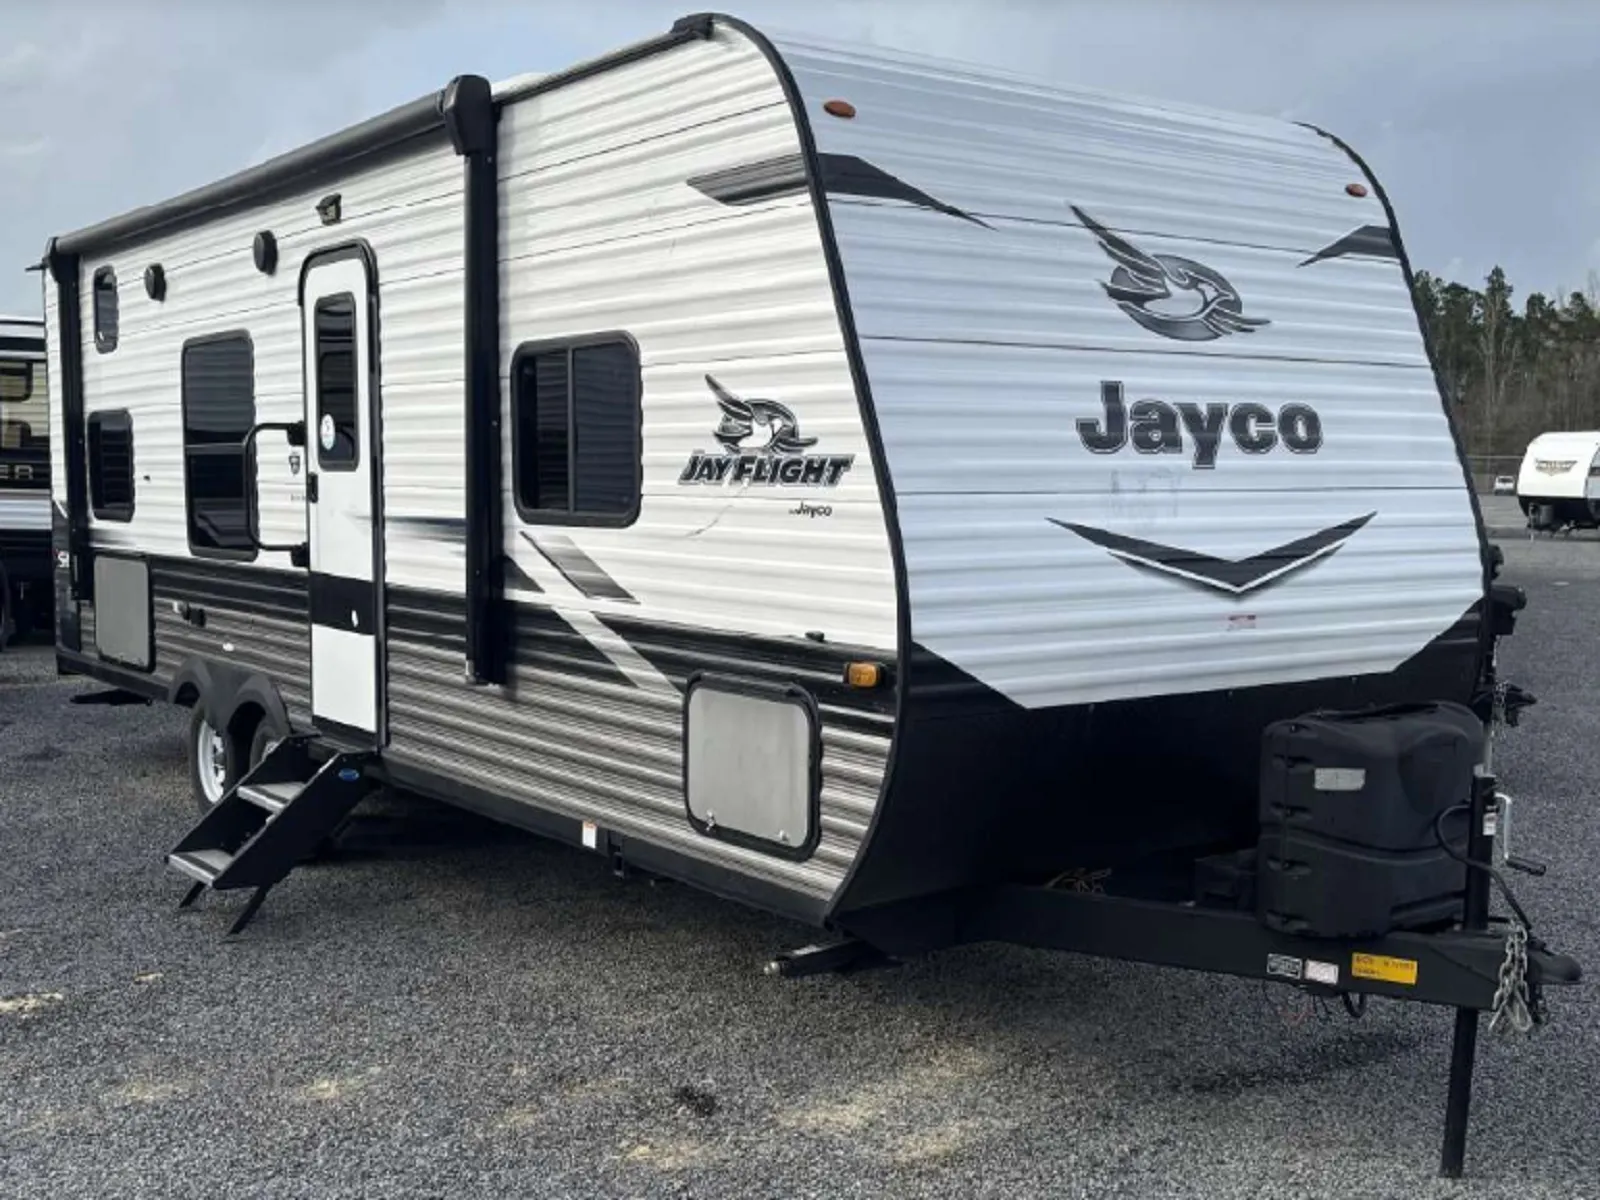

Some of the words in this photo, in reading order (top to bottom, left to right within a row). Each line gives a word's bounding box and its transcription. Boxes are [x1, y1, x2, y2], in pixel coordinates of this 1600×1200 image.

[1075, 380, 1324, 470] Jayco
[678, 450, 735, 485] JAY
[729, 453, 855, 487] FLIGHT
